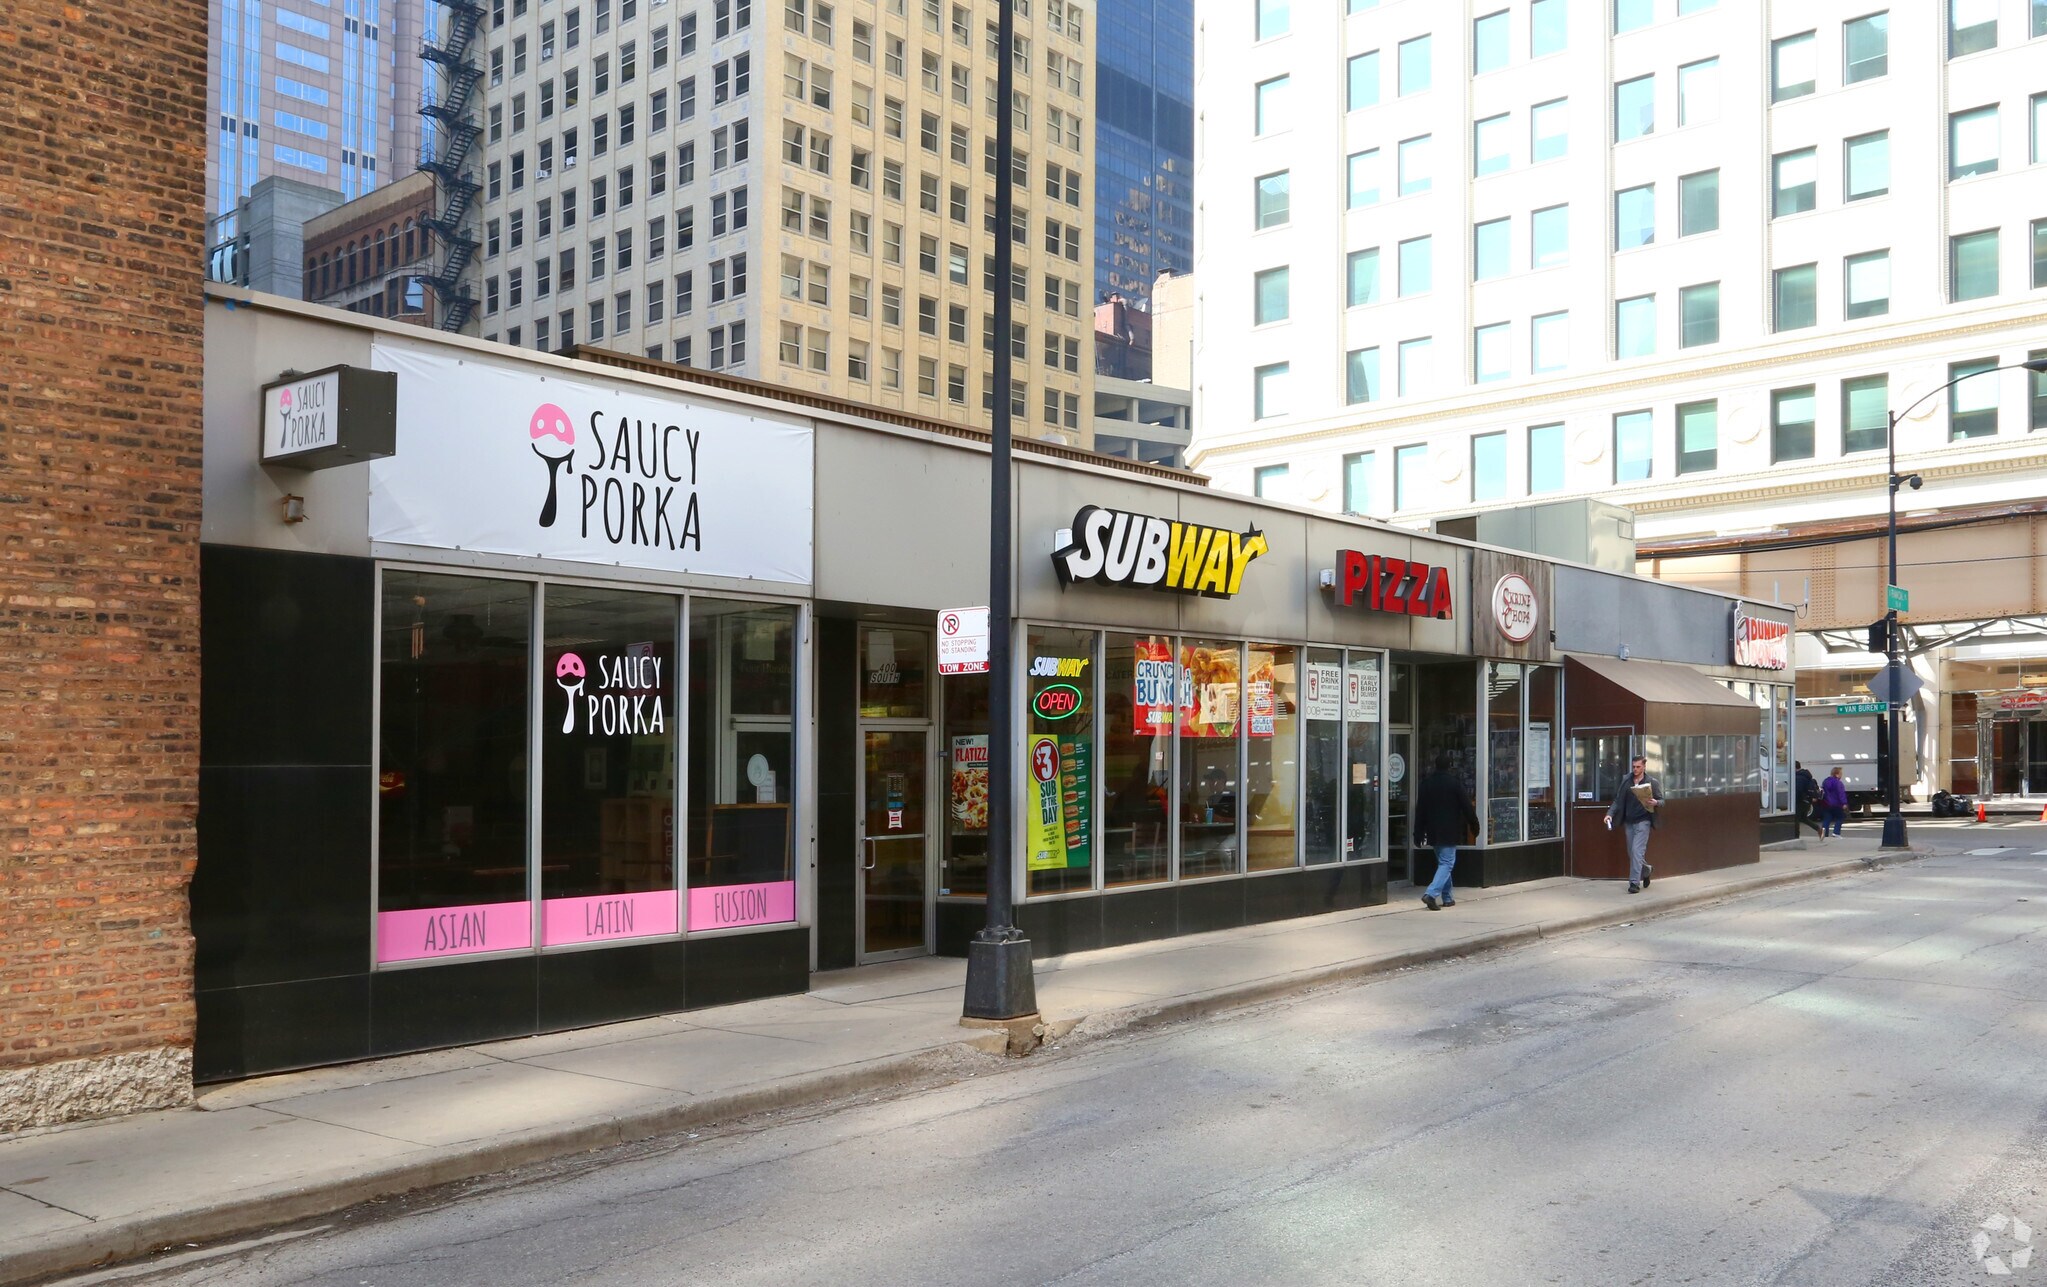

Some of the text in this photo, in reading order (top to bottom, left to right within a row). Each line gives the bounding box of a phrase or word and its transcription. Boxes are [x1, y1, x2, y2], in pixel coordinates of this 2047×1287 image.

[297, 381, 326, 412] SAUCY
[291, 411, 326, 447] PORKA
[588, 410, 700, 485] SAUCY
[581, 473, 701, 552] PORKA
[1064, 508, 1269, 595] SUBWAY
[1341, 549, 1453, 620] PIZZA
[1502, 607, 1531, 629] CHOPS
[950, 639, 977, 647] STOPPING
[950, 646, 977, 654] STANDING
[598, 654, 662, 689] SAUCY
[880, 663, 897, 673] 400
[942, 662, 985, 673] TOW ZONE
[1029, 656, 1090, 677] SUBWAY
[1321, 669, 1339, 677] FREE
[871, 672, 900, 683] SOUTH
[1320, 676, 1339, 684] DRINK
[1039, 692, 1075, 710] OPEN
[1844, 705, 1857, 713] VAN
[1858, 703, 1879, 712] BUREN
[588, 694, 664, 736] PORKA
[955, 738, 974, 746] NEW!
[1036, 745, 1053, 780] $3
[1040, 779, 1057, 798] SUB
[1042, 805, 1058, 825] DAY
[714, 887, 768, 924] FUSION
[585, 898, 634, 936] LATIN
[424, 910, 486, 951] ASIAN
